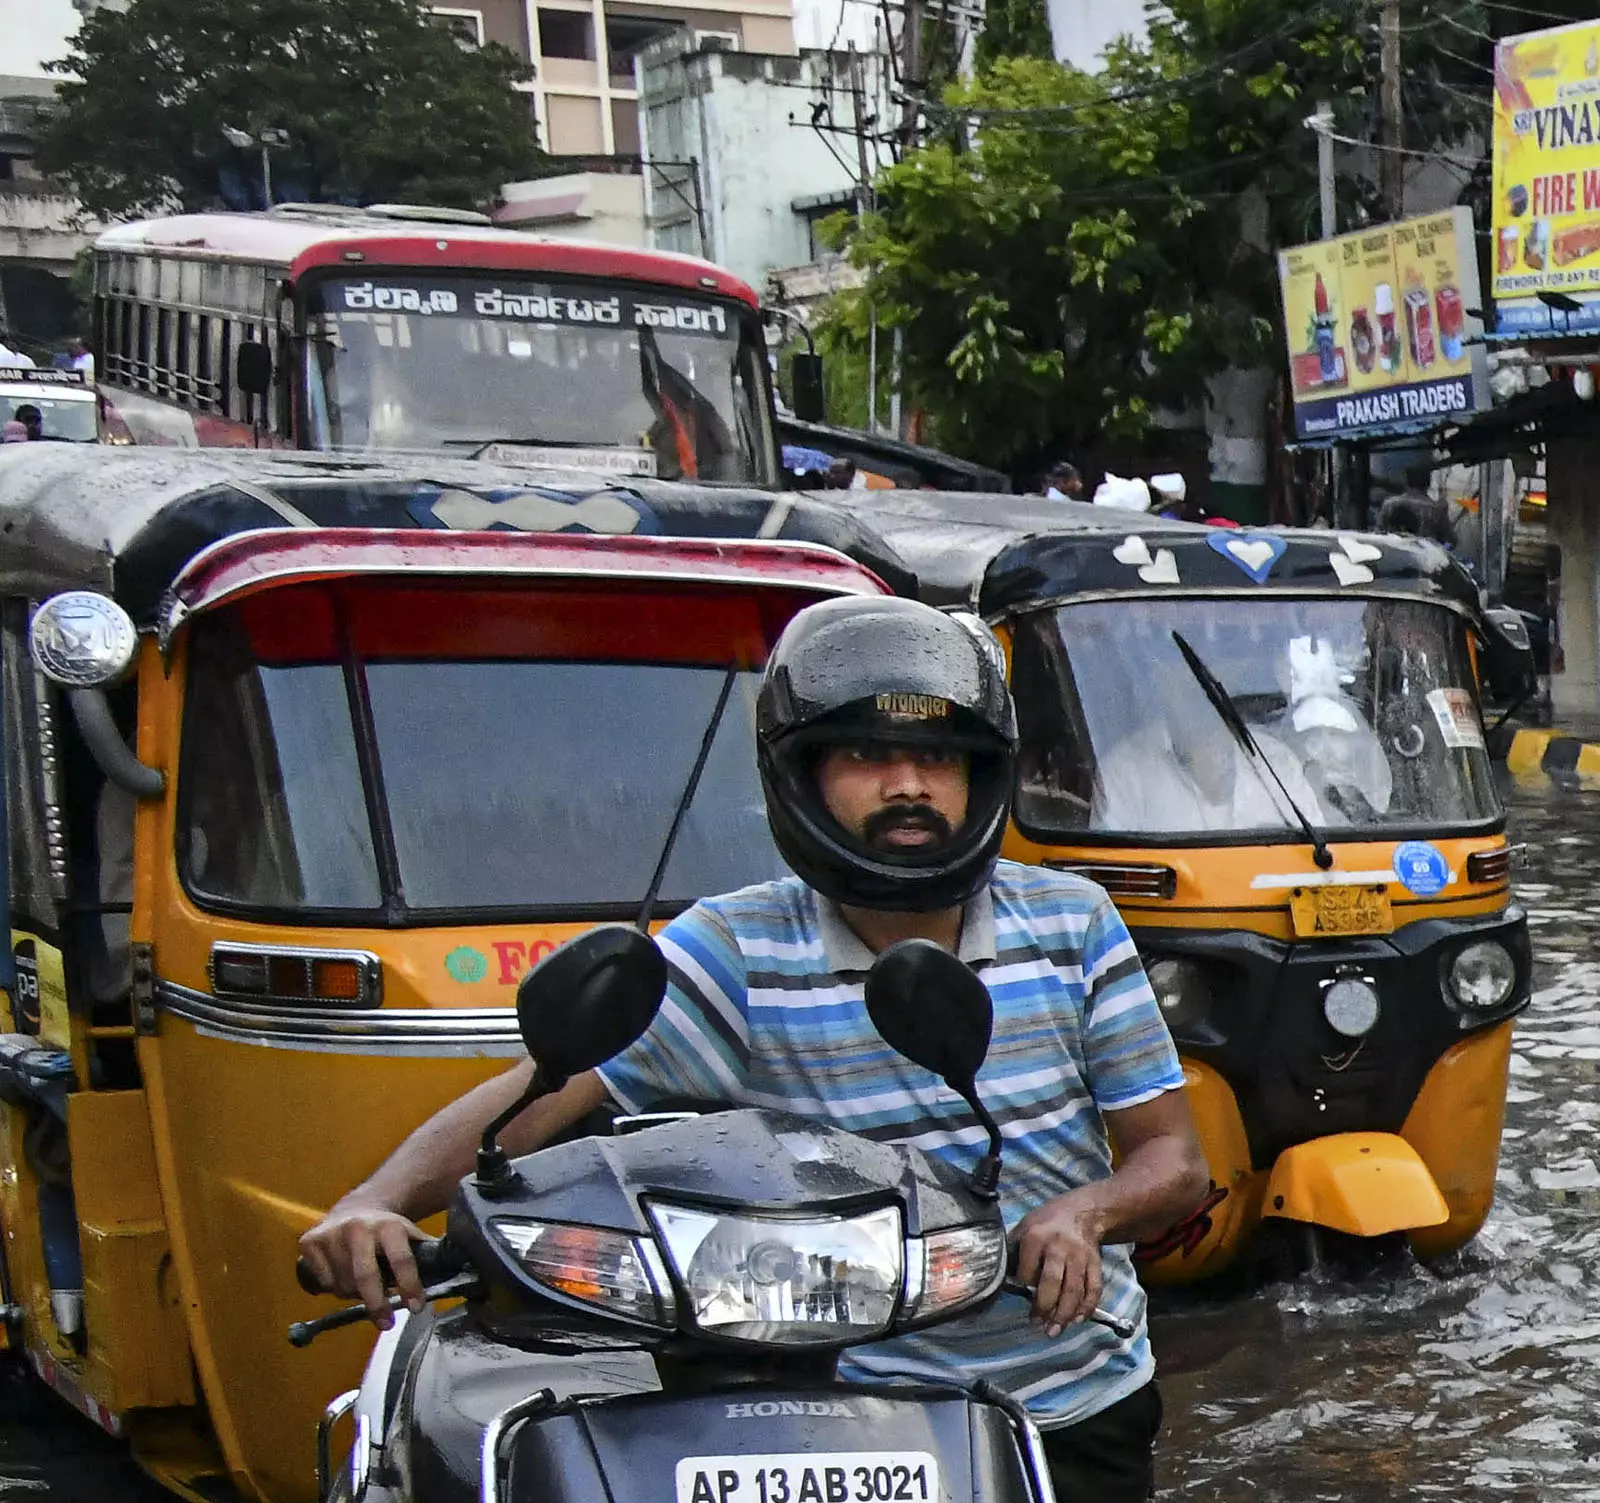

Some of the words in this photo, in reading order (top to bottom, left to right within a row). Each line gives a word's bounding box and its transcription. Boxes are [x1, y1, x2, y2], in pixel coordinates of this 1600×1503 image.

[1532, 172, 1577, 217] FIRE
[1496, 273, 1546, 291] FIREWORKS
[1548, 271, 1565, 286] FOR
[1567, 270, 1586, 283] ANY
[1336, 391, 1400, 427] PRAKASH
[1400, 382, 1467, 417] TRADERS
[725, 1400, 857, 1419] HONDA
[853, 1464, 929, 1503] 3021
